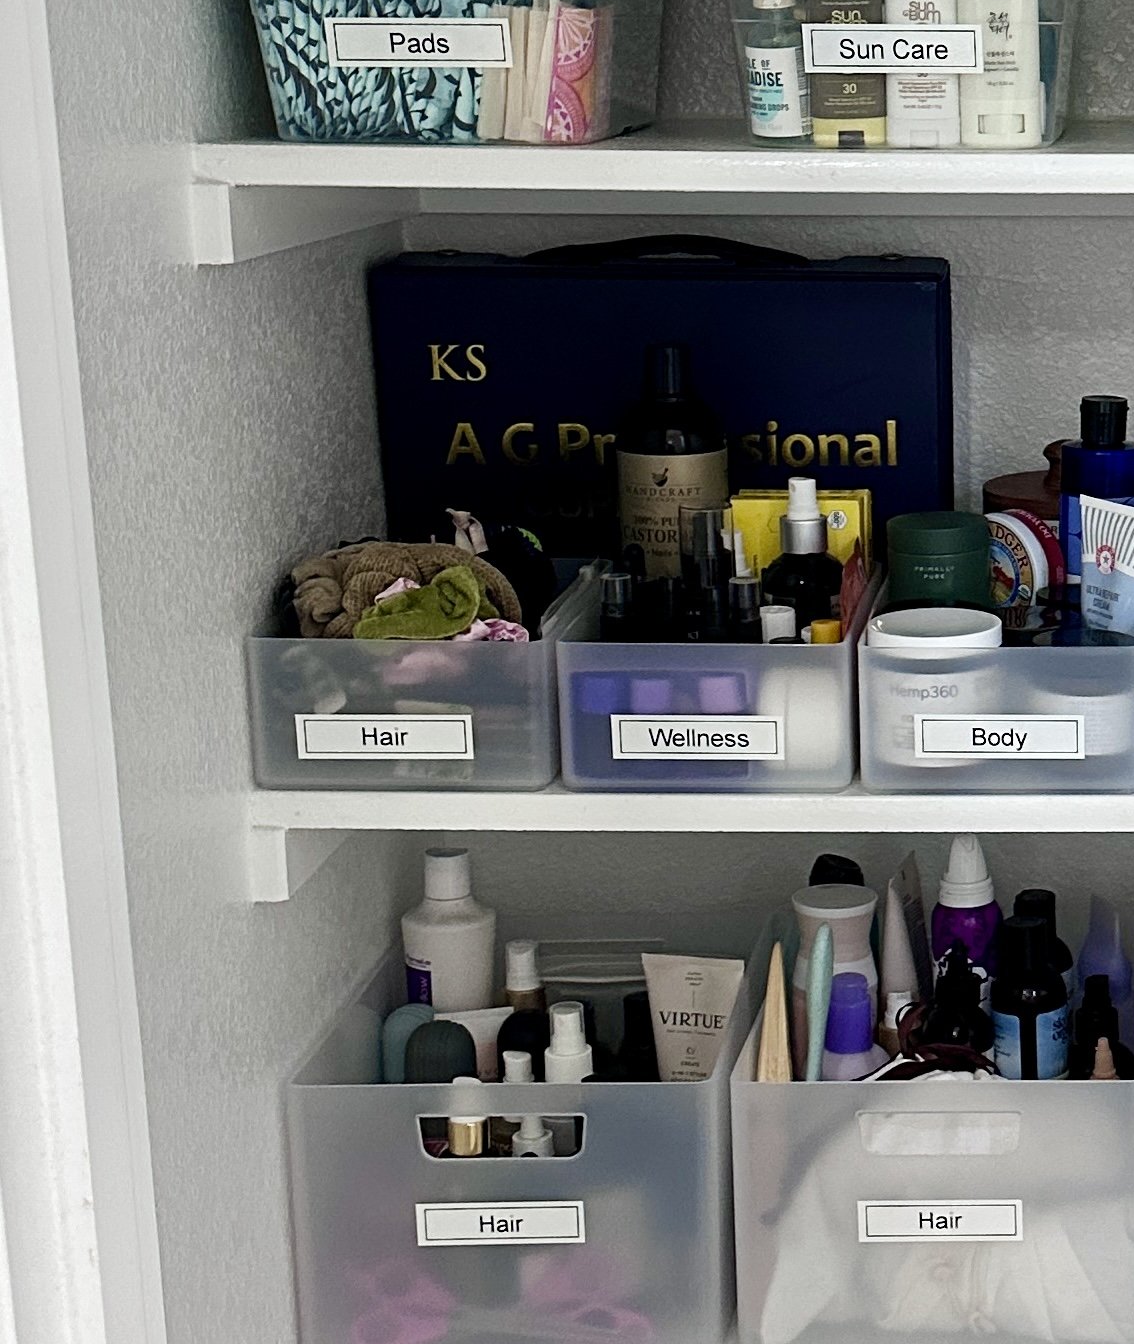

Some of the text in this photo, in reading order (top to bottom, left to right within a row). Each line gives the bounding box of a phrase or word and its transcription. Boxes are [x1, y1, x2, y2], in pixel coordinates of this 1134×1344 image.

[390, 33, 449, 53] Pads
[840, 39, 948, 59] Sun Care
[842, 83, 857, 94] 30
[427, 343, 488, 382] KS
[446, 422, 487, 466] A
[557, 419, 898, 468] Prsional
[362, 727, 408, 745] Hair
[649, 728, 749, 747] Wellness
[973, 728, 1027, 751] Body
[659, 1010, 724, 1030] VIRTUE
[480, 1216, 523, 1232] Hair
[919, 1212, 962, 1229] Hair
